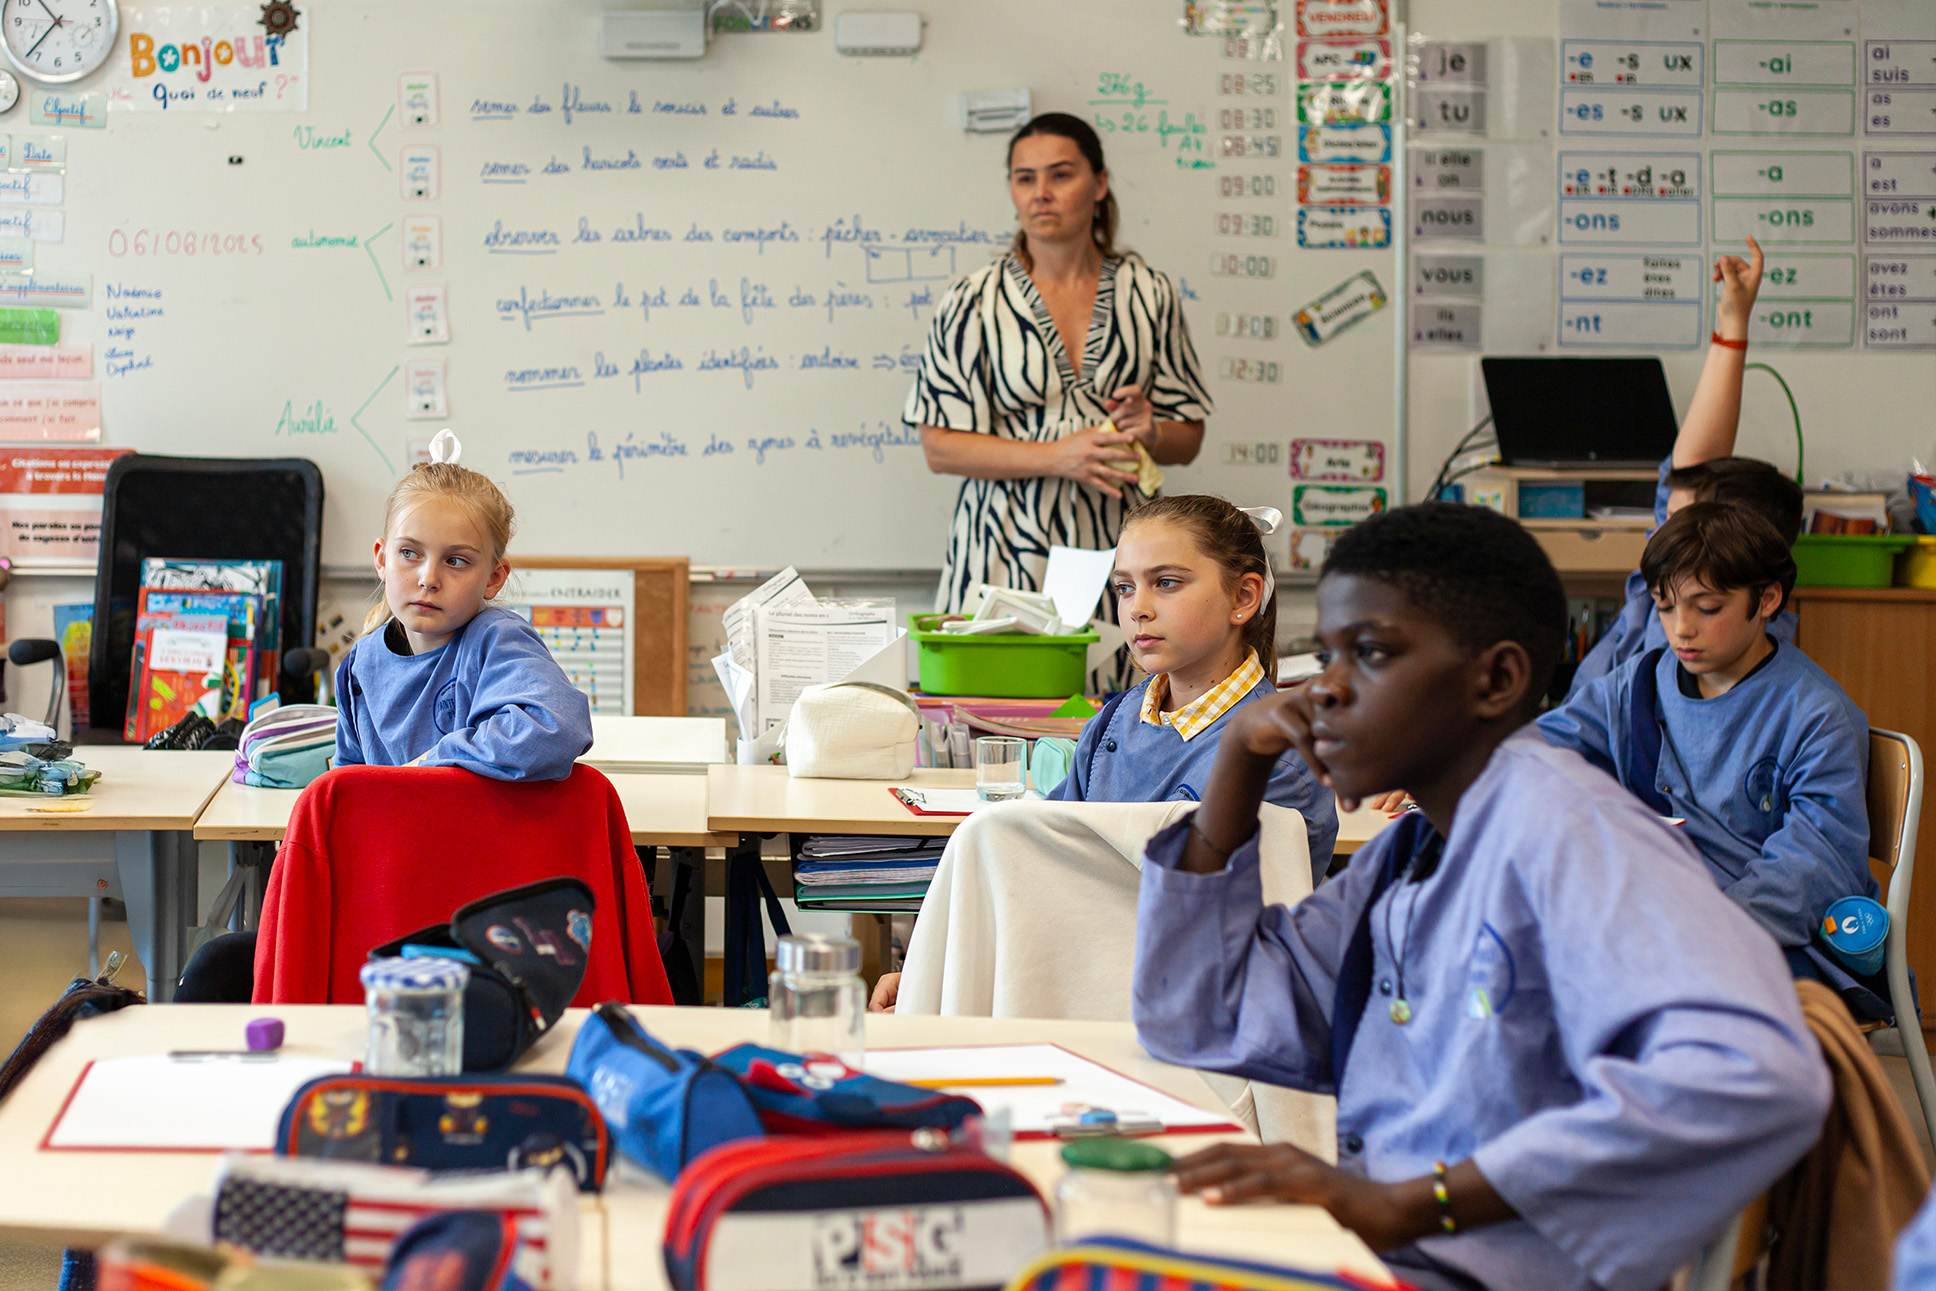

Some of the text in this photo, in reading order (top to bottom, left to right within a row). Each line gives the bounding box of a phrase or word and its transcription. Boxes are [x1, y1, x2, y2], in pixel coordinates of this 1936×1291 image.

[14, 16, 22, 26] 9
[34, 51, 42, 62] 7
[74, 51, 82, 62] 5
[1872, 43, 1891, 61] ai
[53, 57, 62, 67] 6
[1440, 48, 1466, 76] je
[1663, 54, 1693, 72] ux
[1759, 52, 1793, 74] -ai
[1872, 65, 1910, 83] suis
[206, 88, 224, 100] de
[231, 80, 267, 101] neuf
[1872, 93, 1892, 106] as
[1440, 101, 1470, 123] tu
[1659, 105, 1688, 123] ux
[1758, 99, 1798, 118] -as
[1871, 115, 1892, 128] es
[1870, 157, 1883, 171] a
[1758, 165, 1784, 182] -a
[1870, 178, 1898, 193] est
[1869, 201, 1920, 216] avons
[1421, 209, 1474, 226] nous
[1565, 213, 1621, 231] -ons
[1758, 209, 1815, 227] -ons
[1869, 225, 1936, 240] sommes
[1422, 267, 1474, 284] vous
[1570, 267, 1608, 285] -ez
[1869, 261, 1908, 276] avez
[739, 276, 778, 326] fête
[1760, 309, 1814, 329] -ont
[1868, 306, 1899, 320] ont
[1565, 314, 1602, 333] -nt
[1868, 327, 1907, 342] sont
